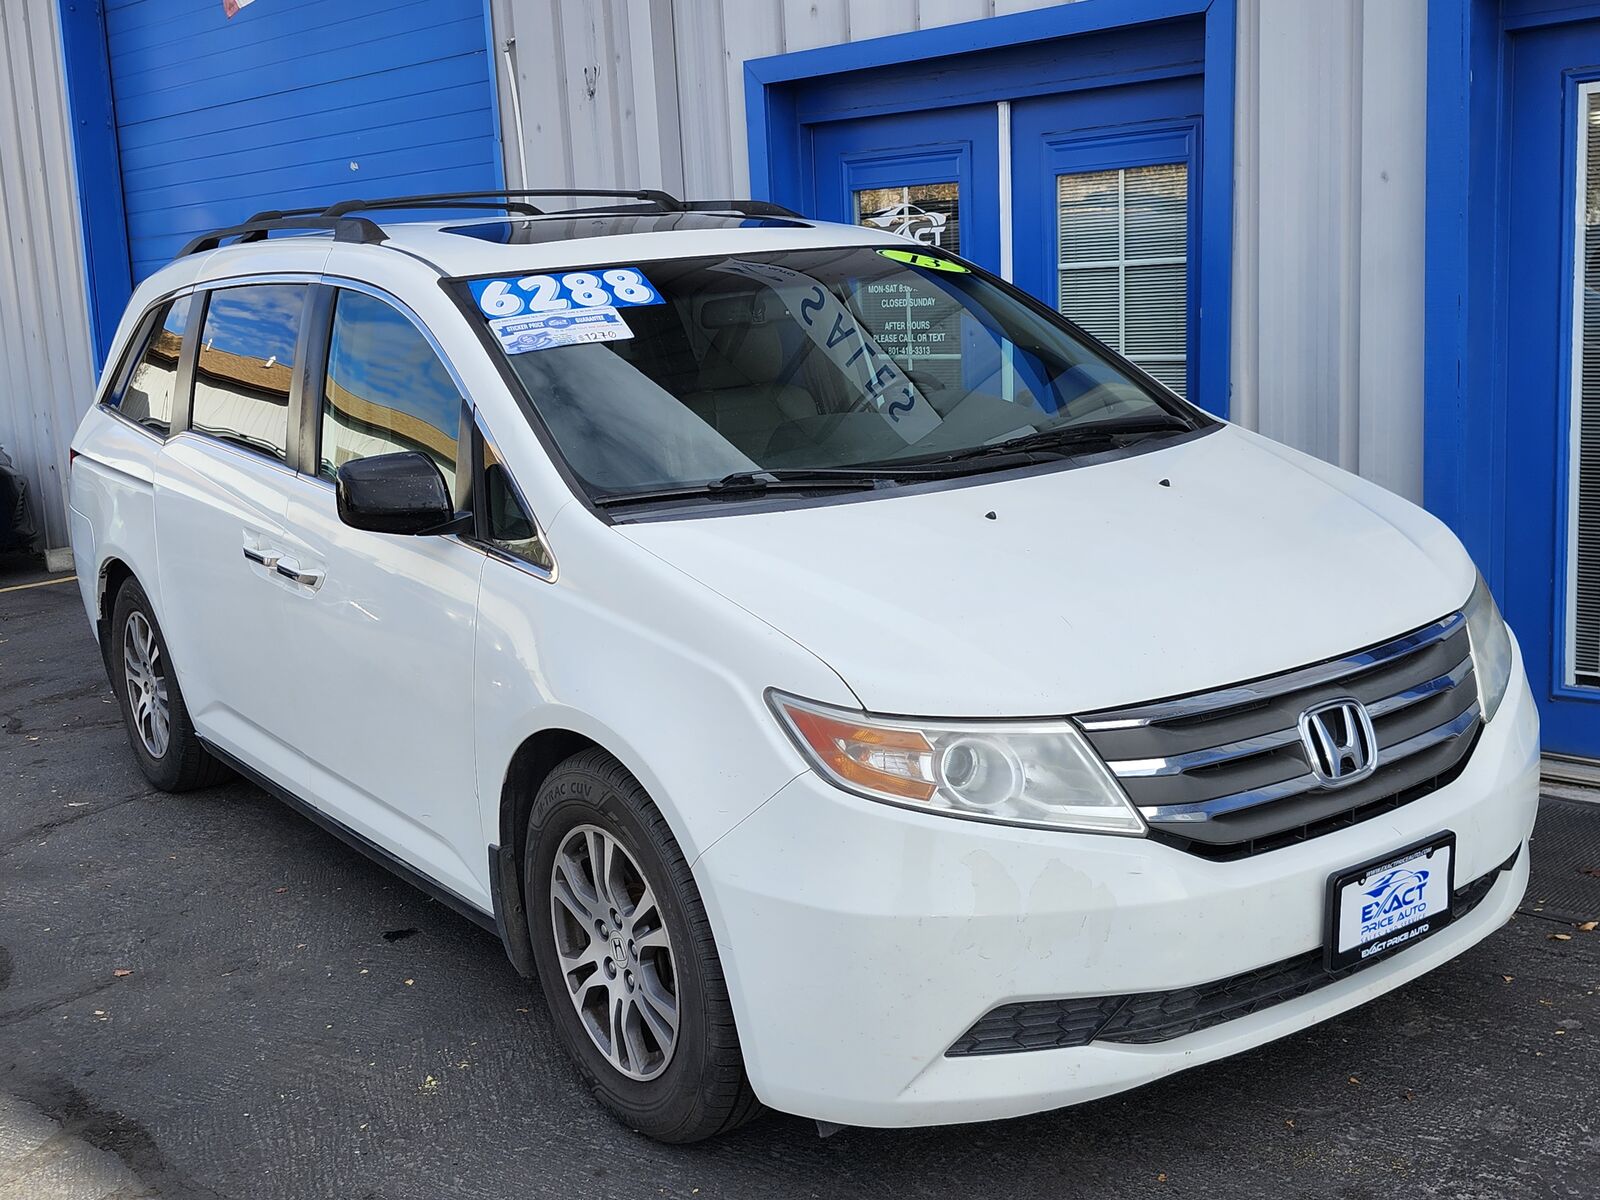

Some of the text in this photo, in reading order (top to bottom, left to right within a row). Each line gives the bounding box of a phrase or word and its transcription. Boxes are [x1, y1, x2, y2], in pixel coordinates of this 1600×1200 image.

[909, 254, 942, 268] 13
[480, 269, 655, 317] 6288
[868, 284, 898, 294] MON-SAT
[881, 297, 936, 308] CLOSED SUNDAY
[528, 321, 545, 329] PRICE
[884, 321, 930, 330] AFTER HOURS
[873, 333, 946, 343] PLEASE CALL OR TEXT
[570, 782, 592, 797] CUV
[1361, 881, 1428, 923] EXACT
[1361, 902, 1427, 935] PRICE AUTO
[1361, 923, 1430, 959] EXACT PRICE AUTO
